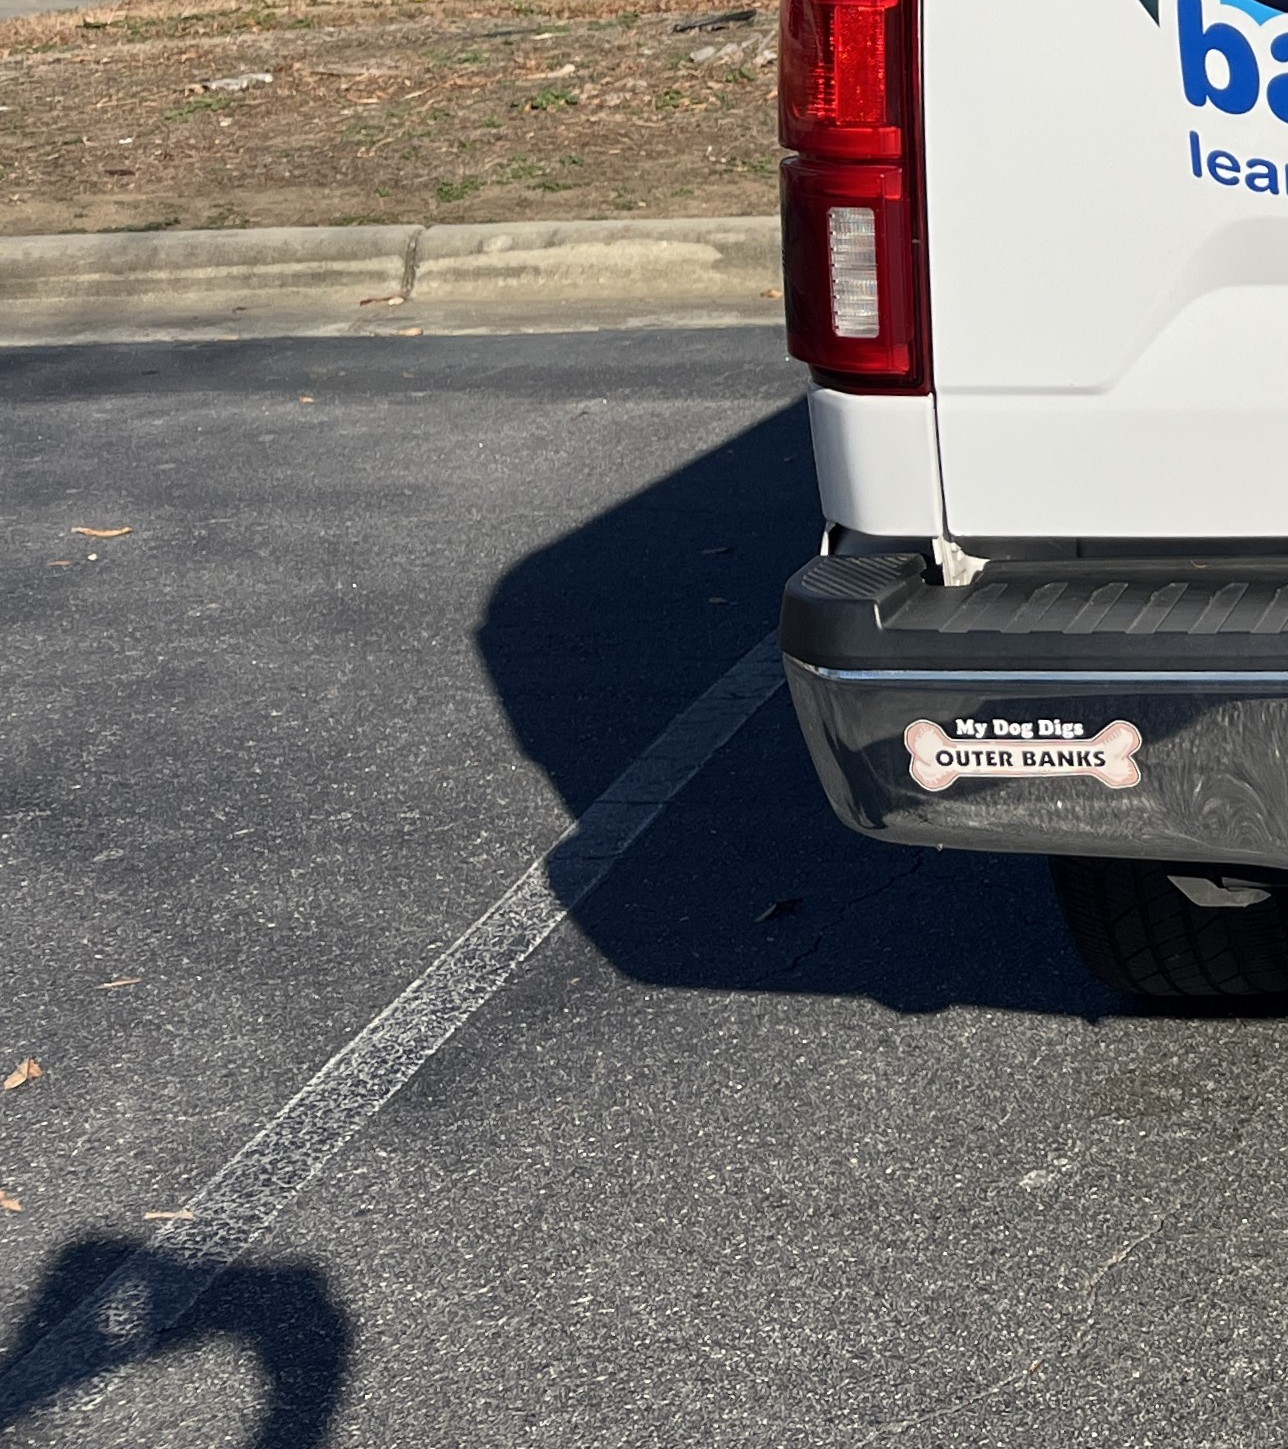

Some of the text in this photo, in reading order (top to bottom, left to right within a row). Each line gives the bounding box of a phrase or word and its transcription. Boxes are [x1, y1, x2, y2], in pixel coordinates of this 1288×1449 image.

[954, 718, 1084, 740] My Dog Digs
[935, 748, 1107, 768] OUTER BANKS
